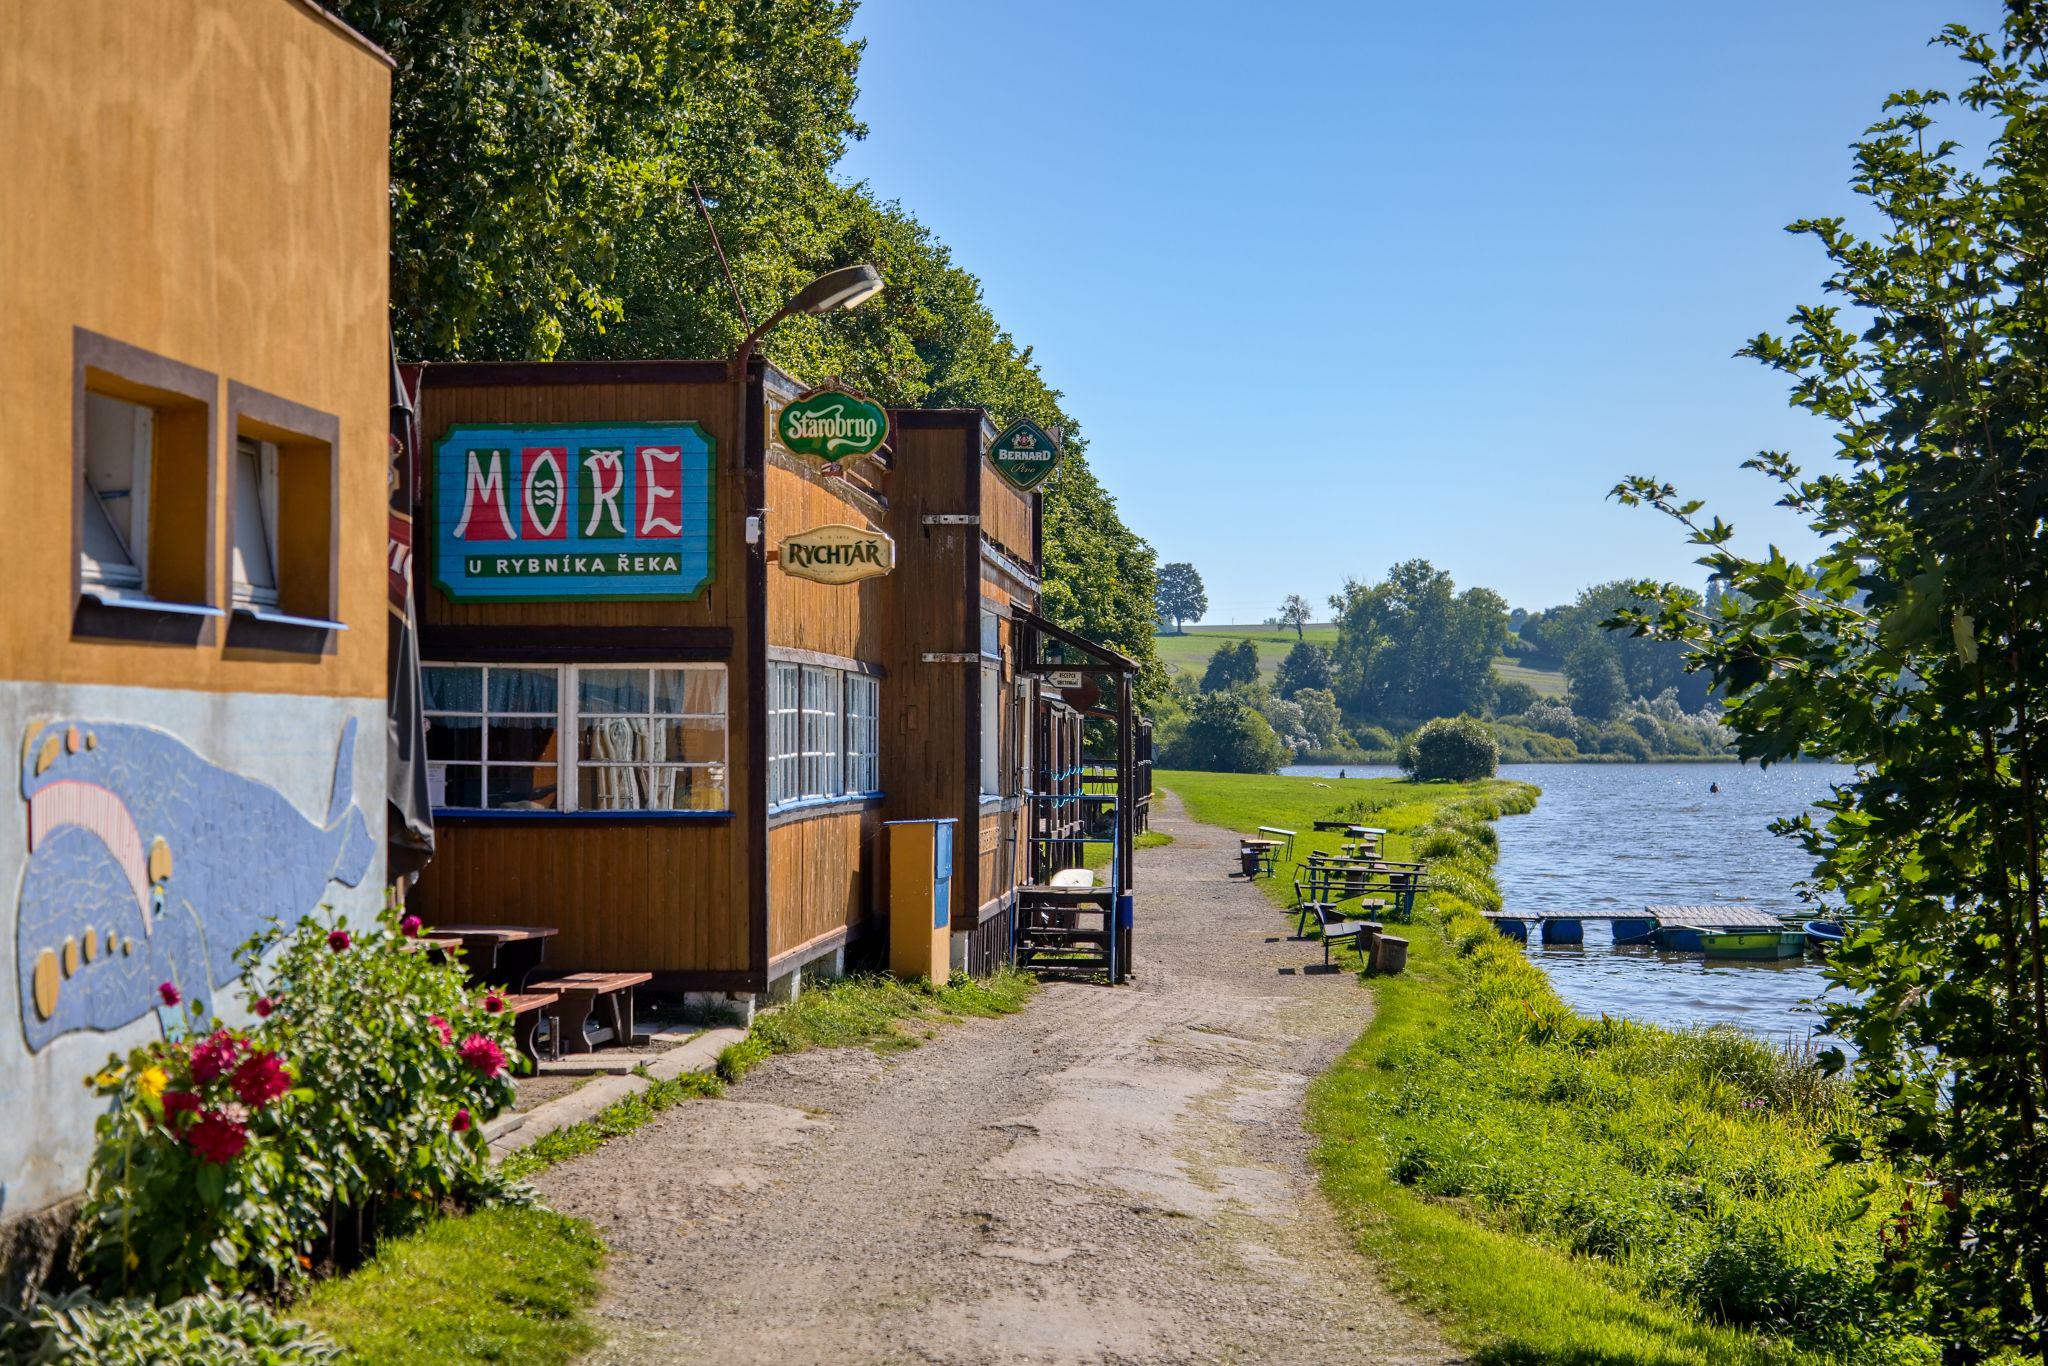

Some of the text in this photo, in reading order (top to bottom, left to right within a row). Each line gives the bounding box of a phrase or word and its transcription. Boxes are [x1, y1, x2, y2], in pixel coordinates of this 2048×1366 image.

[788, 404, 877, 451] Starobrno
[998, 449, 1051, 461] BERNARD
[453, 448, 682, 540] MOŘE
[469, 553, 678, 574] U RYBNÍKA ŘEKA
[789, 540, 885, 568] RYCHTÁŘ
